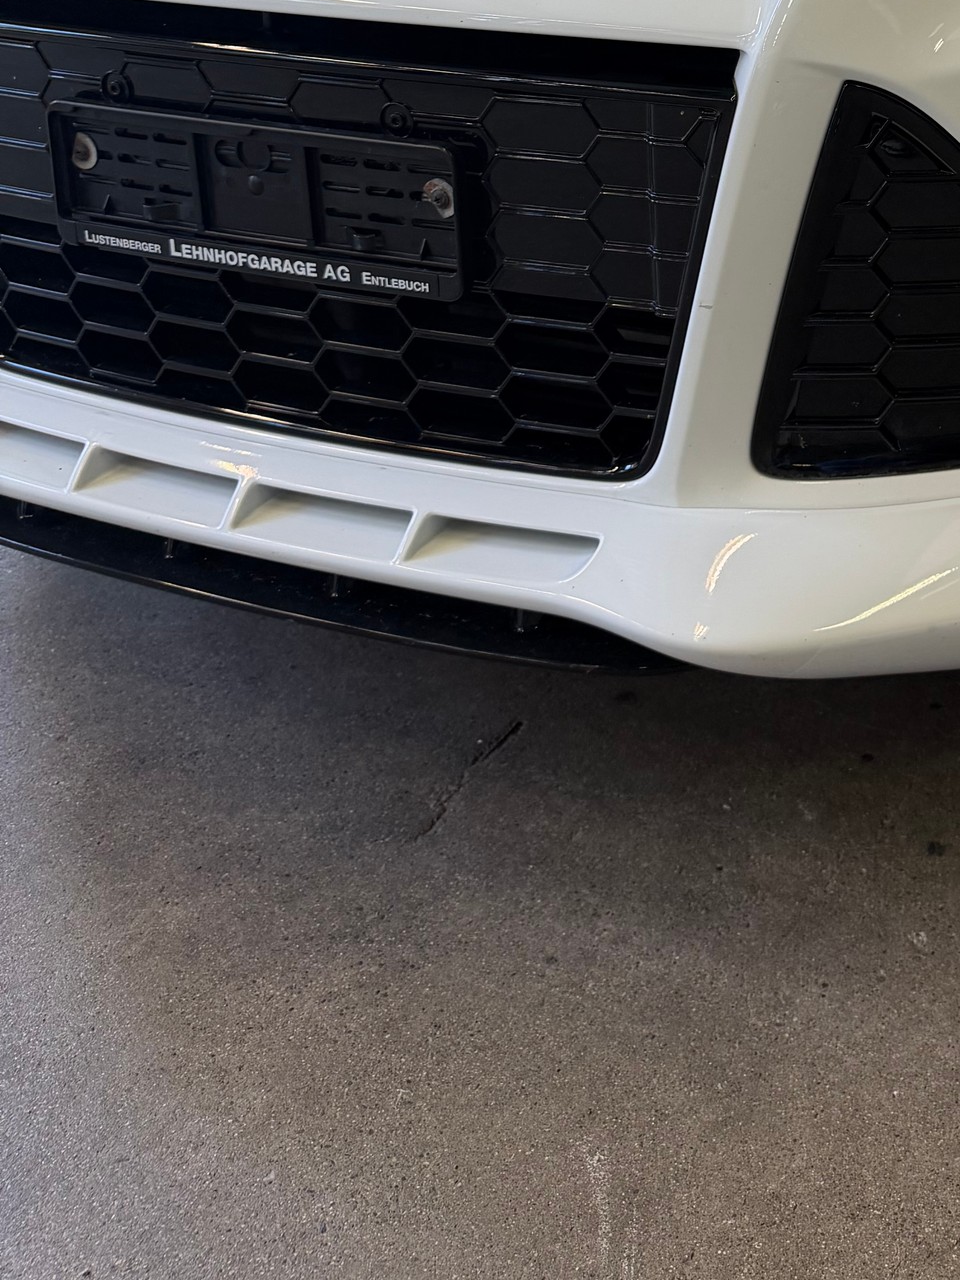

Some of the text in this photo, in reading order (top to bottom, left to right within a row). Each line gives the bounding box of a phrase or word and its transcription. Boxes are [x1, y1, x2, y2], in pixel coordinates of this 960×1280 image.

[84, 230, 430, 293] LUSTENBERGER LEHNHOFGARAGE AG ENTLEBUCH
